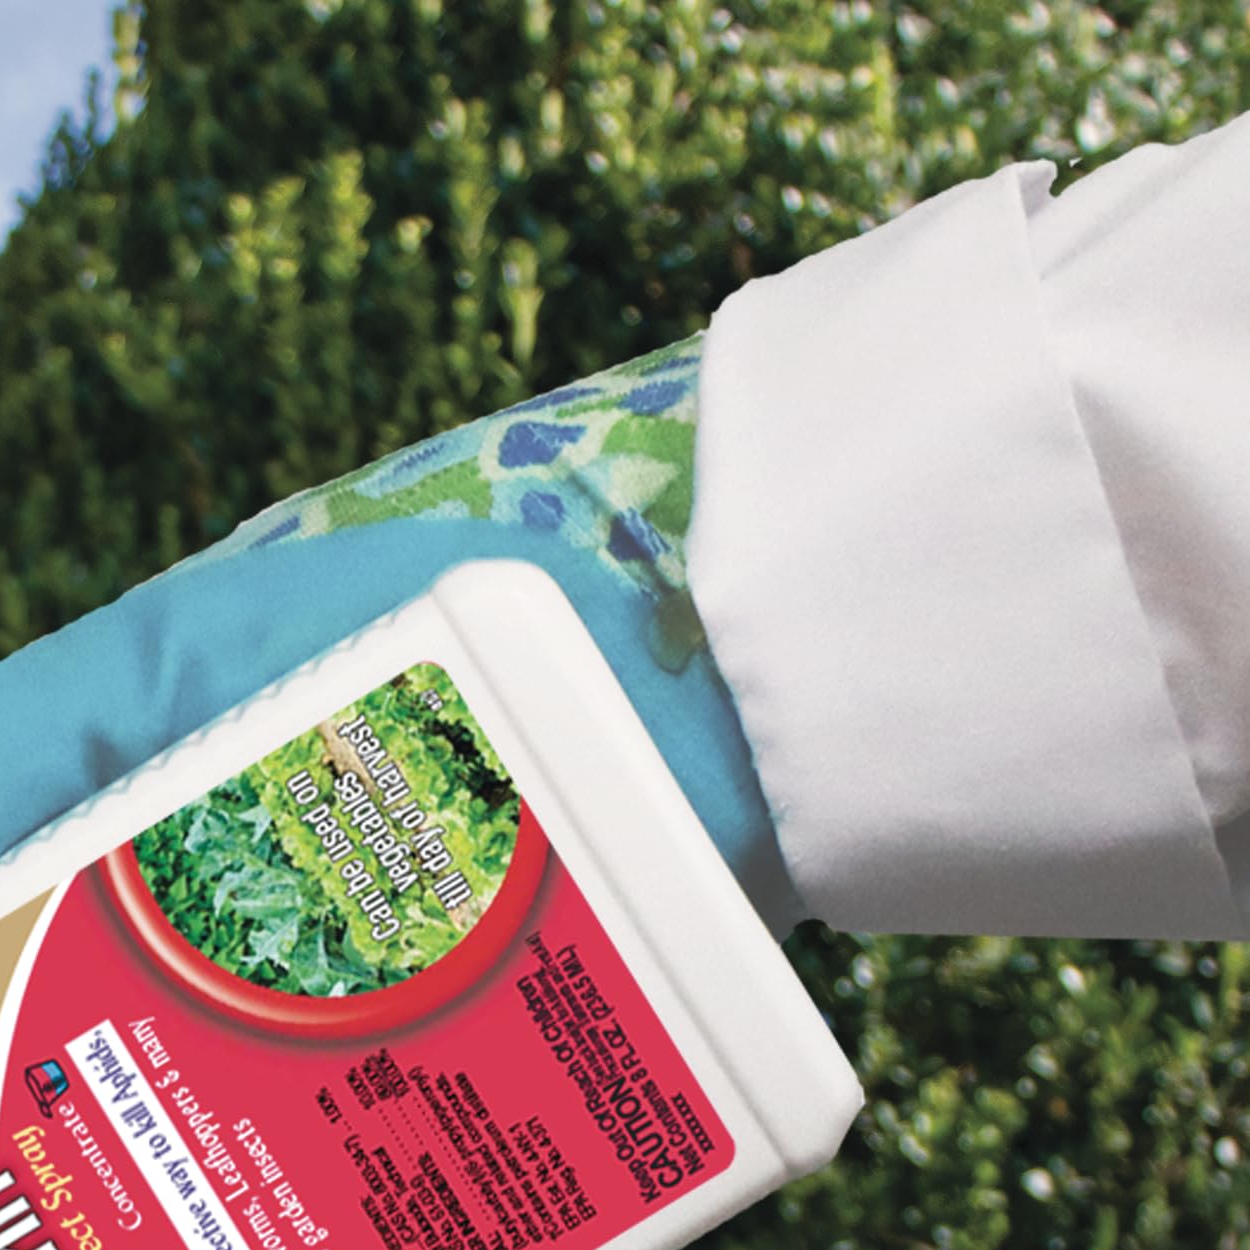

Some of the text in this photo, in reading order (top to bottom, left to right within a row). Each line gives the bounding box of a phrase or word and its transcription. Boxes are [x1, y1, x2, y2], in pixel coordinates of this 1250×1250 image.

[335, 770, 417, 890] vegetables
[337, 715, 471, 909] till day of harvest
[286, 770, 400, 940] Can be used on
[85, 1029, 138, 1103] Aphids,
[127, 1016, 170, 1069] many
[629, 1066, 648, 1083] 8
[154, 1069, 180, 1088] &
[515, 974, 663, 1204] Keep Out Of Reach Of Children
[639, 1078, 687, 1148] Contents
[120, 1100, 157, 1139] kill
[148, 1133, 172, 1159] to
[171, 1086, 249, 1202] Leafhoppers
[232, 1117, 283, 1187] insects
[601, 1074, 684, 1189] CAUTION
[12, 1125, 73, 1210] Spray
[58, 1103, 142, 1230] Concentrate
[162, 1157, 196, 1200] way
[677, 1142, 705, 1176] Net
[272, 1180, 329, 1246] garden
